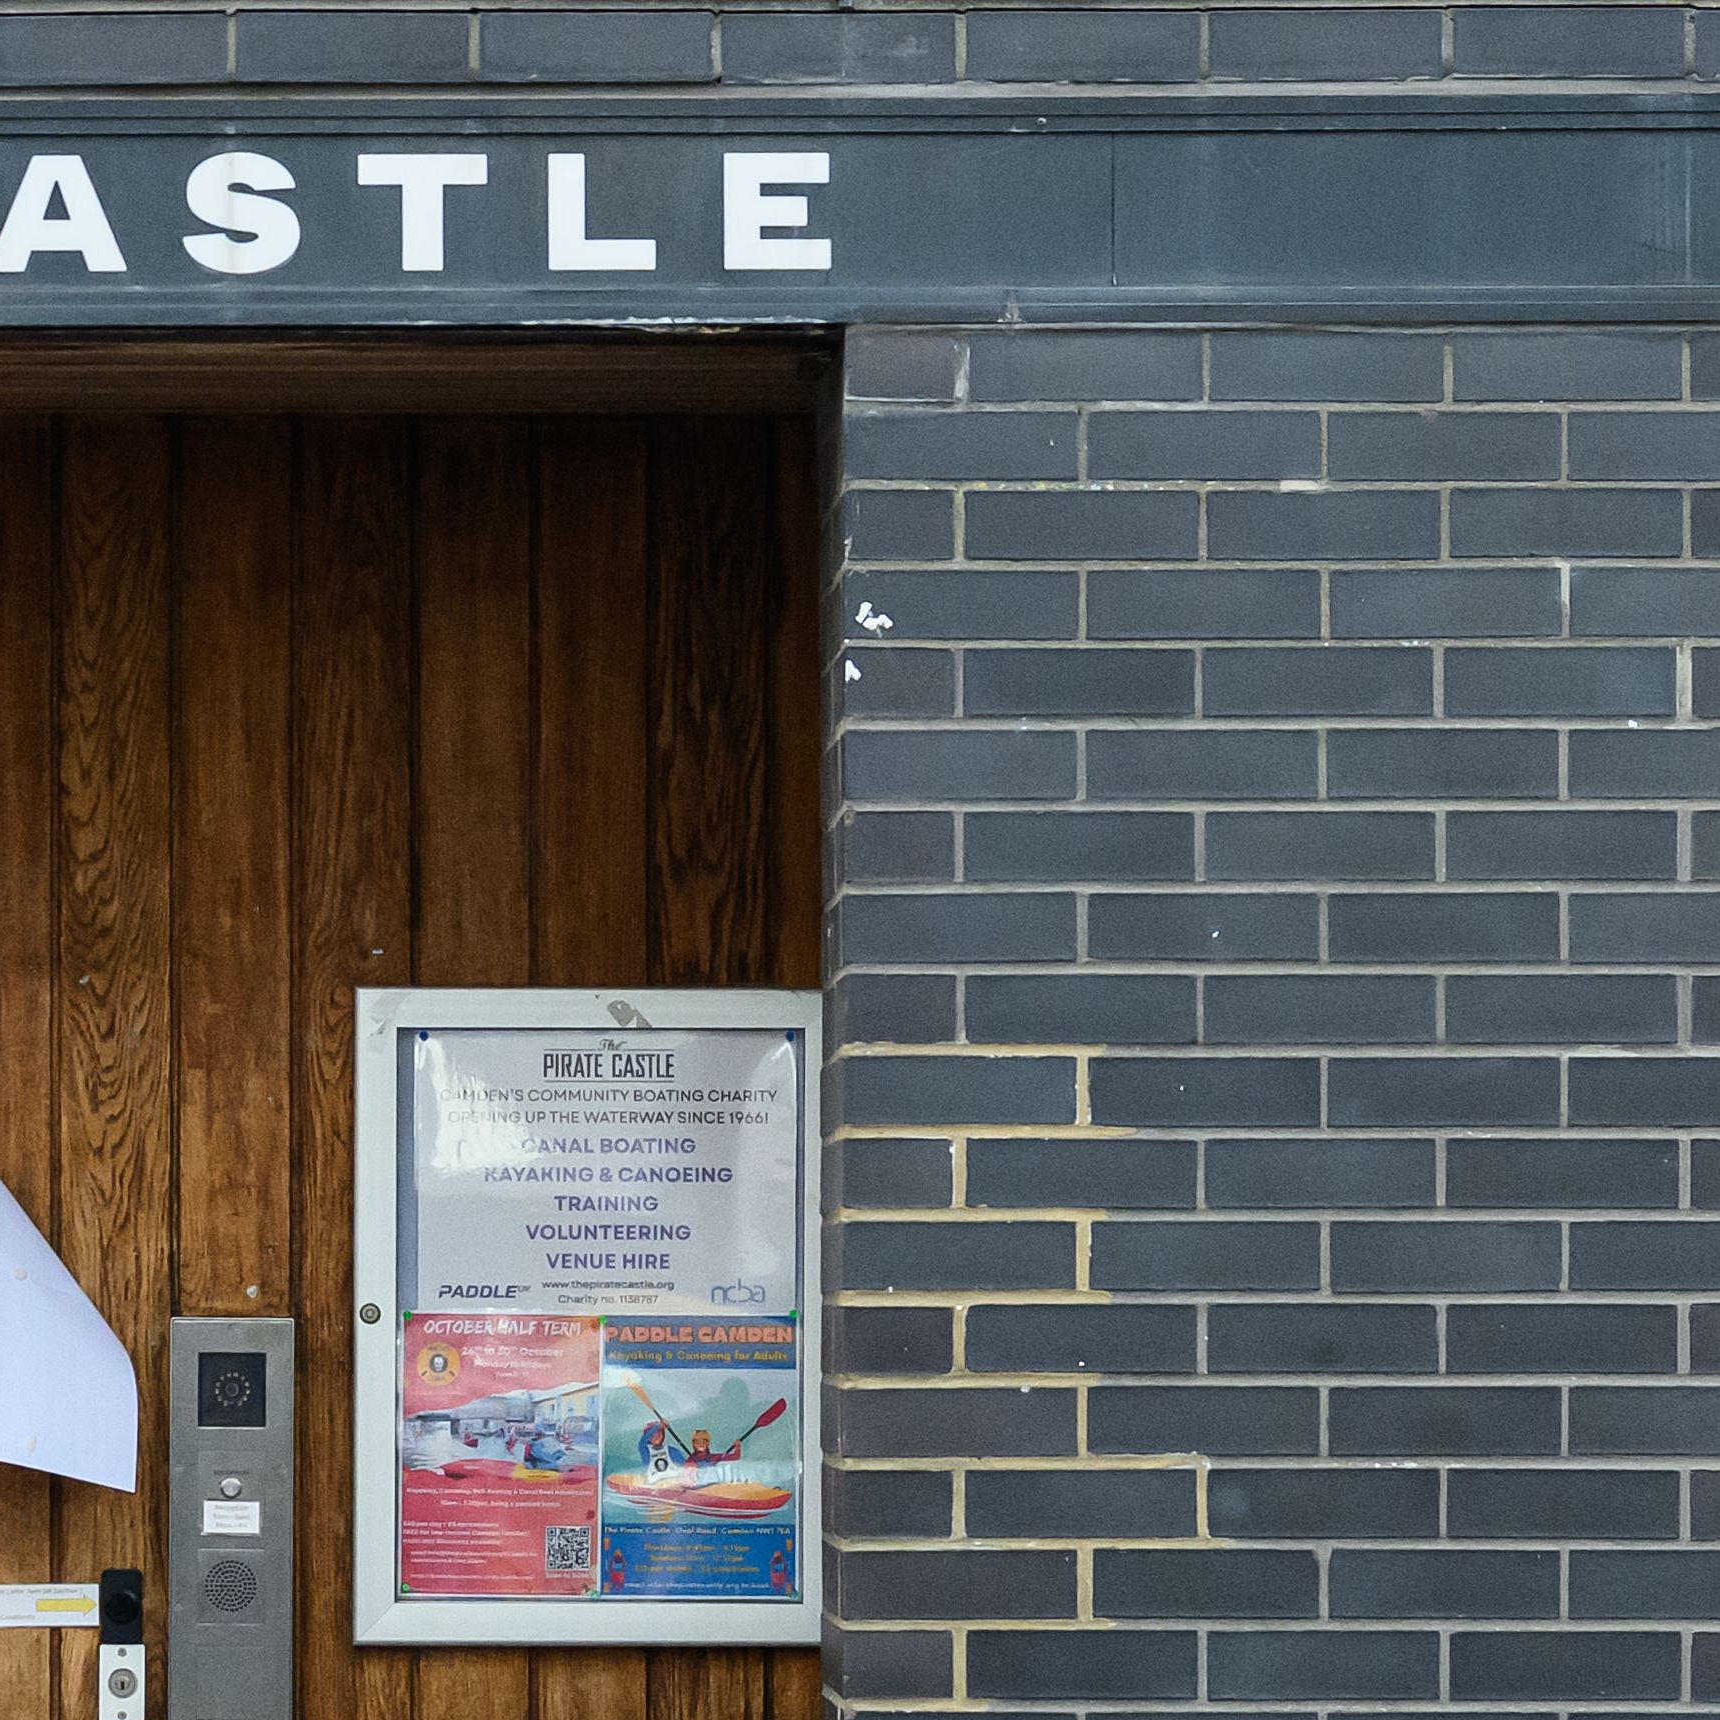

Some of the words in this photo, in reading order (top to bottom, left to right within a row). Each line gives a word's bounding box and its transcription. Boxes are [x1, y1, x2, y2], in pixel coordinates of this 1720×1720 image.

[599, 1039, 627, 1051] The
[543, 1053, 603, 1078] PIRATE
[612, 1053, 674, 1078] CASTLE
[528, 1088, 629, 1102] COMMUNITY
[634, 1088, 704, 1102] BOATING
[708, 1088, 777, 1102] CHARITY
[525, 1110, 546, 1124] UP
[549, 1110, 579, 1124] THE
[583, 1110, 674, 1124] WATERWAY
[677, 1110, 725, 1124] SINCE
[729, 1110, 769, 1124] 1966!
[522, 1137, 594, 1154] CANAL
[600, 1137, 696, 1154] BOATING
[484, 1167, 594, 1183] KAYAKING
[599, 1167, 613, 1183] &
[618, 1167, 733, 1183] CANOEING
[554, 1195, 658, 1212] TRAINING
[525, 1224, 691, 1241] VOLUNTEERING
[546, 1253, 616, 1270] VENUE
[622, 1253, 671, 1270] HIRE
[438, 1285, 518, 1299] PADDLE
[542, 1280, 675, 1291] www.thepiratecastle.org
[711, 1278, 766, 1303] ncba
[558, 1294, 598, 1305] Charity
[423, 1319, 494, 1336] OCTOBER
[497, 1319, 538, 1336] HALF
[542, 1321, 582, 1337] TERM
[606, 1325, 693, 1344] PADDLE
[697, 1325, 793, 1344] CAMDEN
